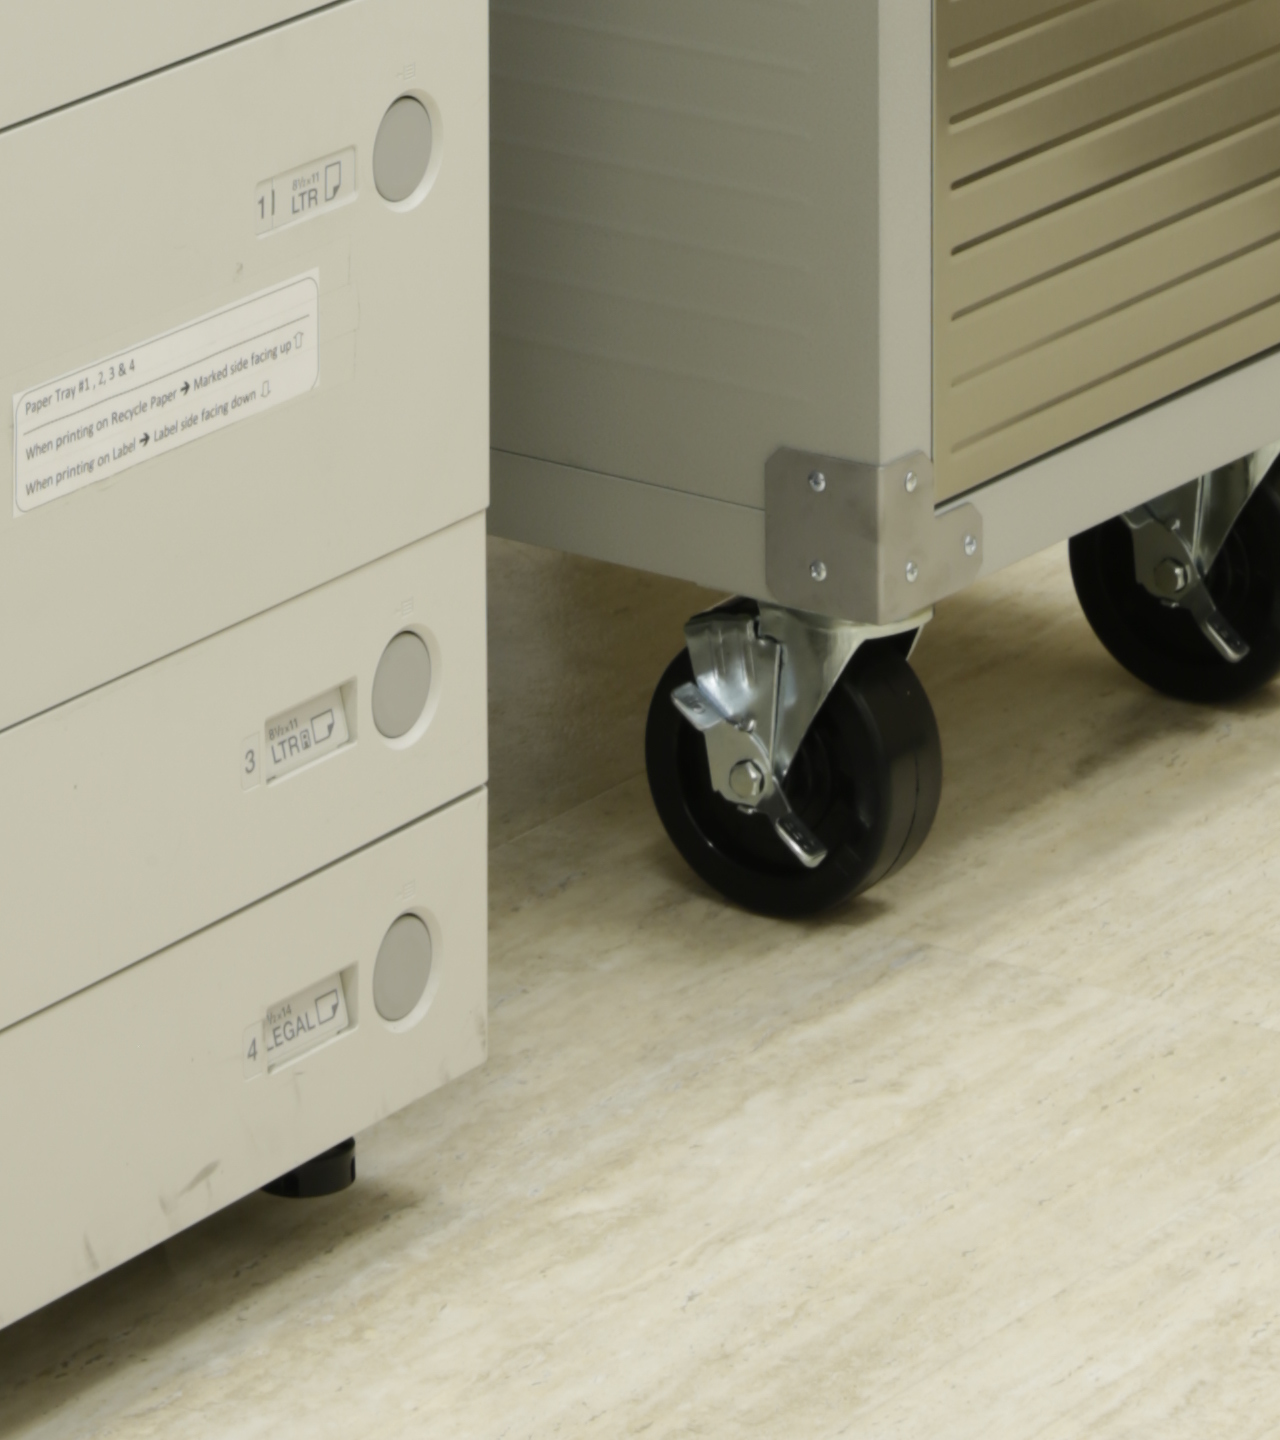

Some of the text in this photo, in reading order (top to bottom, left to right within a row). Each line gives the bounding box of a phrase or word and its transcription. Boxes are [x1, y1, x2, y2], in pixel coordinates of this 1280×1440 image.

[258, 195, 265, 220] 1
[291, 187, 318, 215] LTR
[25, 394, 52, 416] Paper
[55, 385, 76, 403] Tray
[109, 366, 115, 381] 3
[118, 362, 127, 377] &
[129, 358, 135, 372] 4
[25, 340, 292, 461] When printing on Recycle Paper Marked side facing up
[25, 390, 256, 496] When printing on Label Label side facing down
[245, 748, 256, 774] 3
[271, 734, 300, 765] LTR
[247, 1036, 258, 1062] 4
